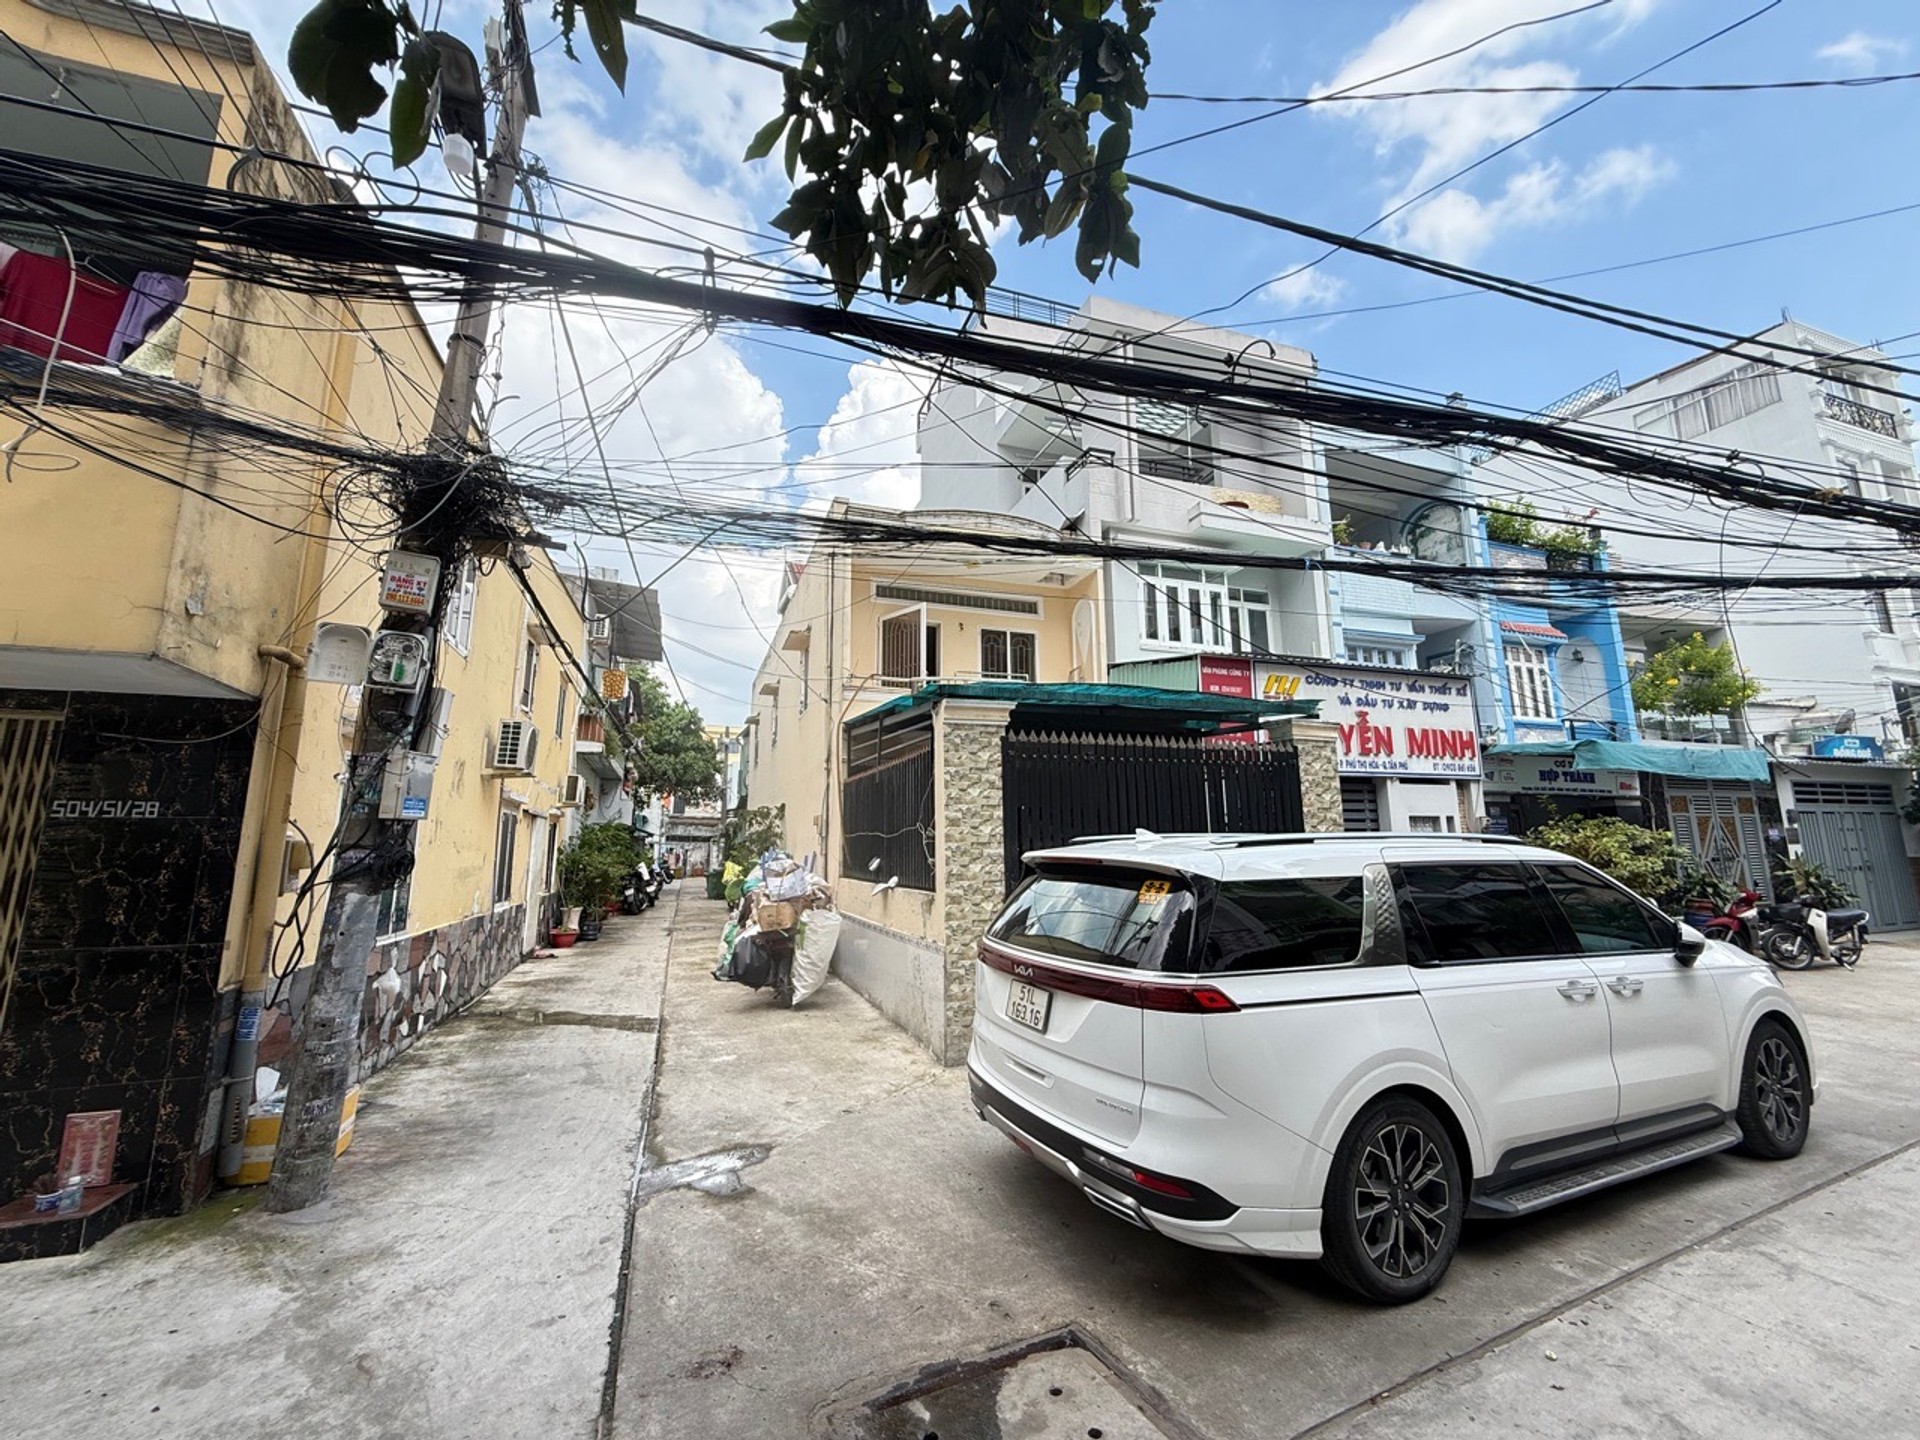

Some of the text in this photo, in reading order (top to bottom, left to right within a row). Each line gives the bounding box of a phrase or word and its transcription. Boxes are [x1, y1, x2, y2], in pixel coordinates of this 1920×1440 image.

[1305, 673, 1338, 687] CÔNG
[1359, 680, 1386, 692] TNHH
[1389, 682, 1403, 692] TƯ
[1406, 679, 1426, 695] VẤN
[1428, 681, 1452, 696] THIẾT
[1337, 691, 1450, 715] VÀ ĐẦU TƯ XÂY DỰNG
[1405, 727, 1477, 760] MINH
[50, 800, 160, 818] 504/51/28
[1014, 964, 1033, 977] KIA
[1018, 985, 1036, 1006] 51L
[1011, 1000, 1041, 1026] 163.16
